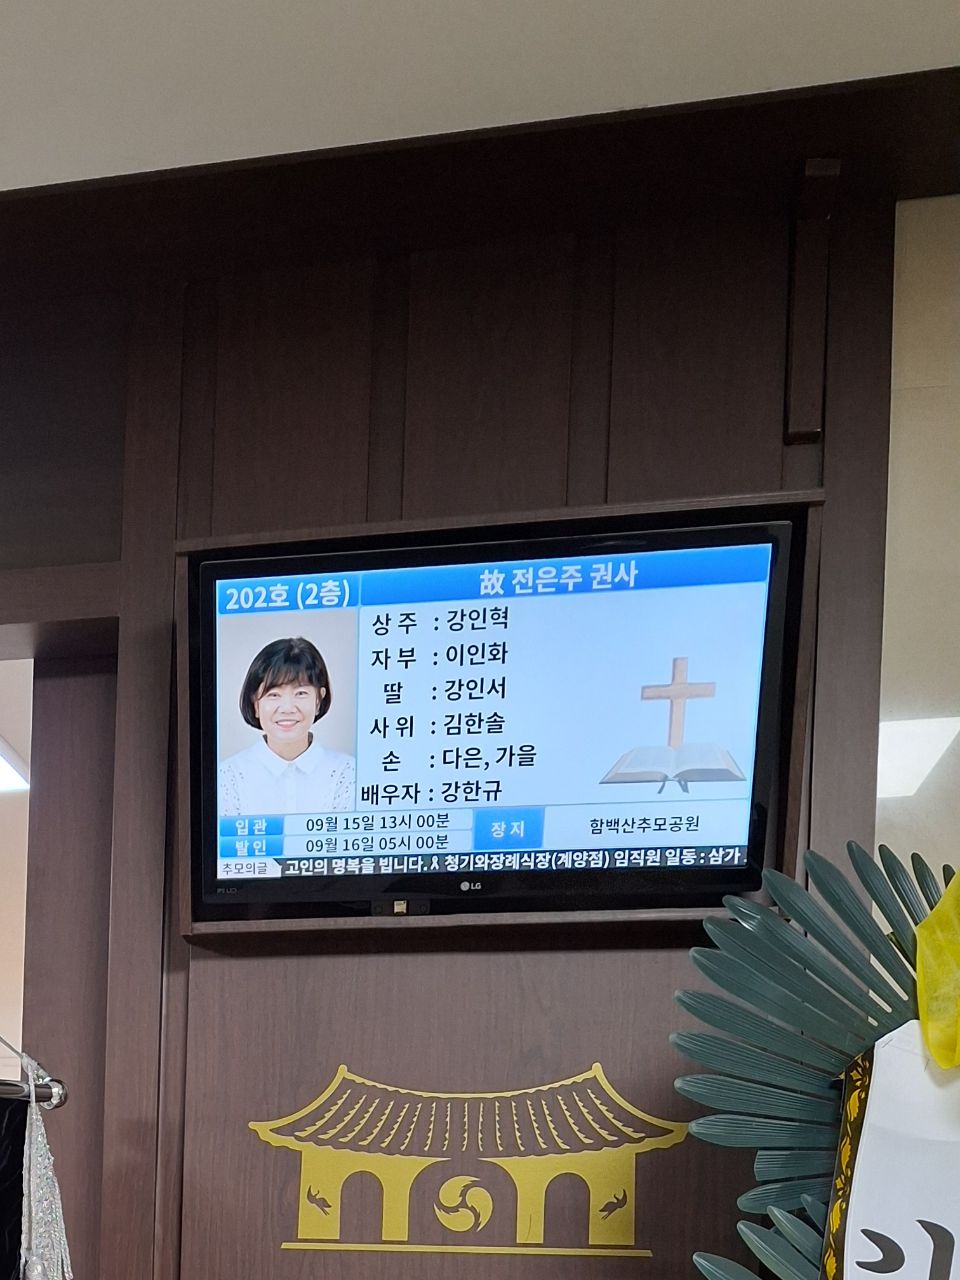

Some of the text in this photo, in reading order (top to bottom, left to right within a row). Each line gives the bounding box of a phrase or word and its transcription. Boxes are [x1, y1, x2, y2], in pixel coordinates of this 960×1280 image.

[479, 560, 638, 596] 故 전은주 권사
[225, 578, 350, 611] 202호 (2층)
[446, 606, 509, 632] 강인혁
[445, 642, 508, 667] 이인화
[383, 682, 403, 704] 딸
[444, 676, 506, 701] 강인서
[443, 711, 506, 736] 김한솔
[382, 751, 401, 772] 손
[361, 782, 421, 806] 배우자
[441, 780, 503, 803] 강한규
[306, 812, 450, 833] 09월 15일 13시 00분
[590, 815, 700, 835] 함백산추모공원
[306, 834, 450, 853] 09월 16일 05시 00분
[285, 858, 328, 875] 고인의
[332, 857, 375, 874] 명복을
[379, 856, 428, 874] 빕니다.
[614, 849, 661, 867] 임직원
[665, 848, 696, 866] 일동
[708, 847, 740, 865] 삼가
